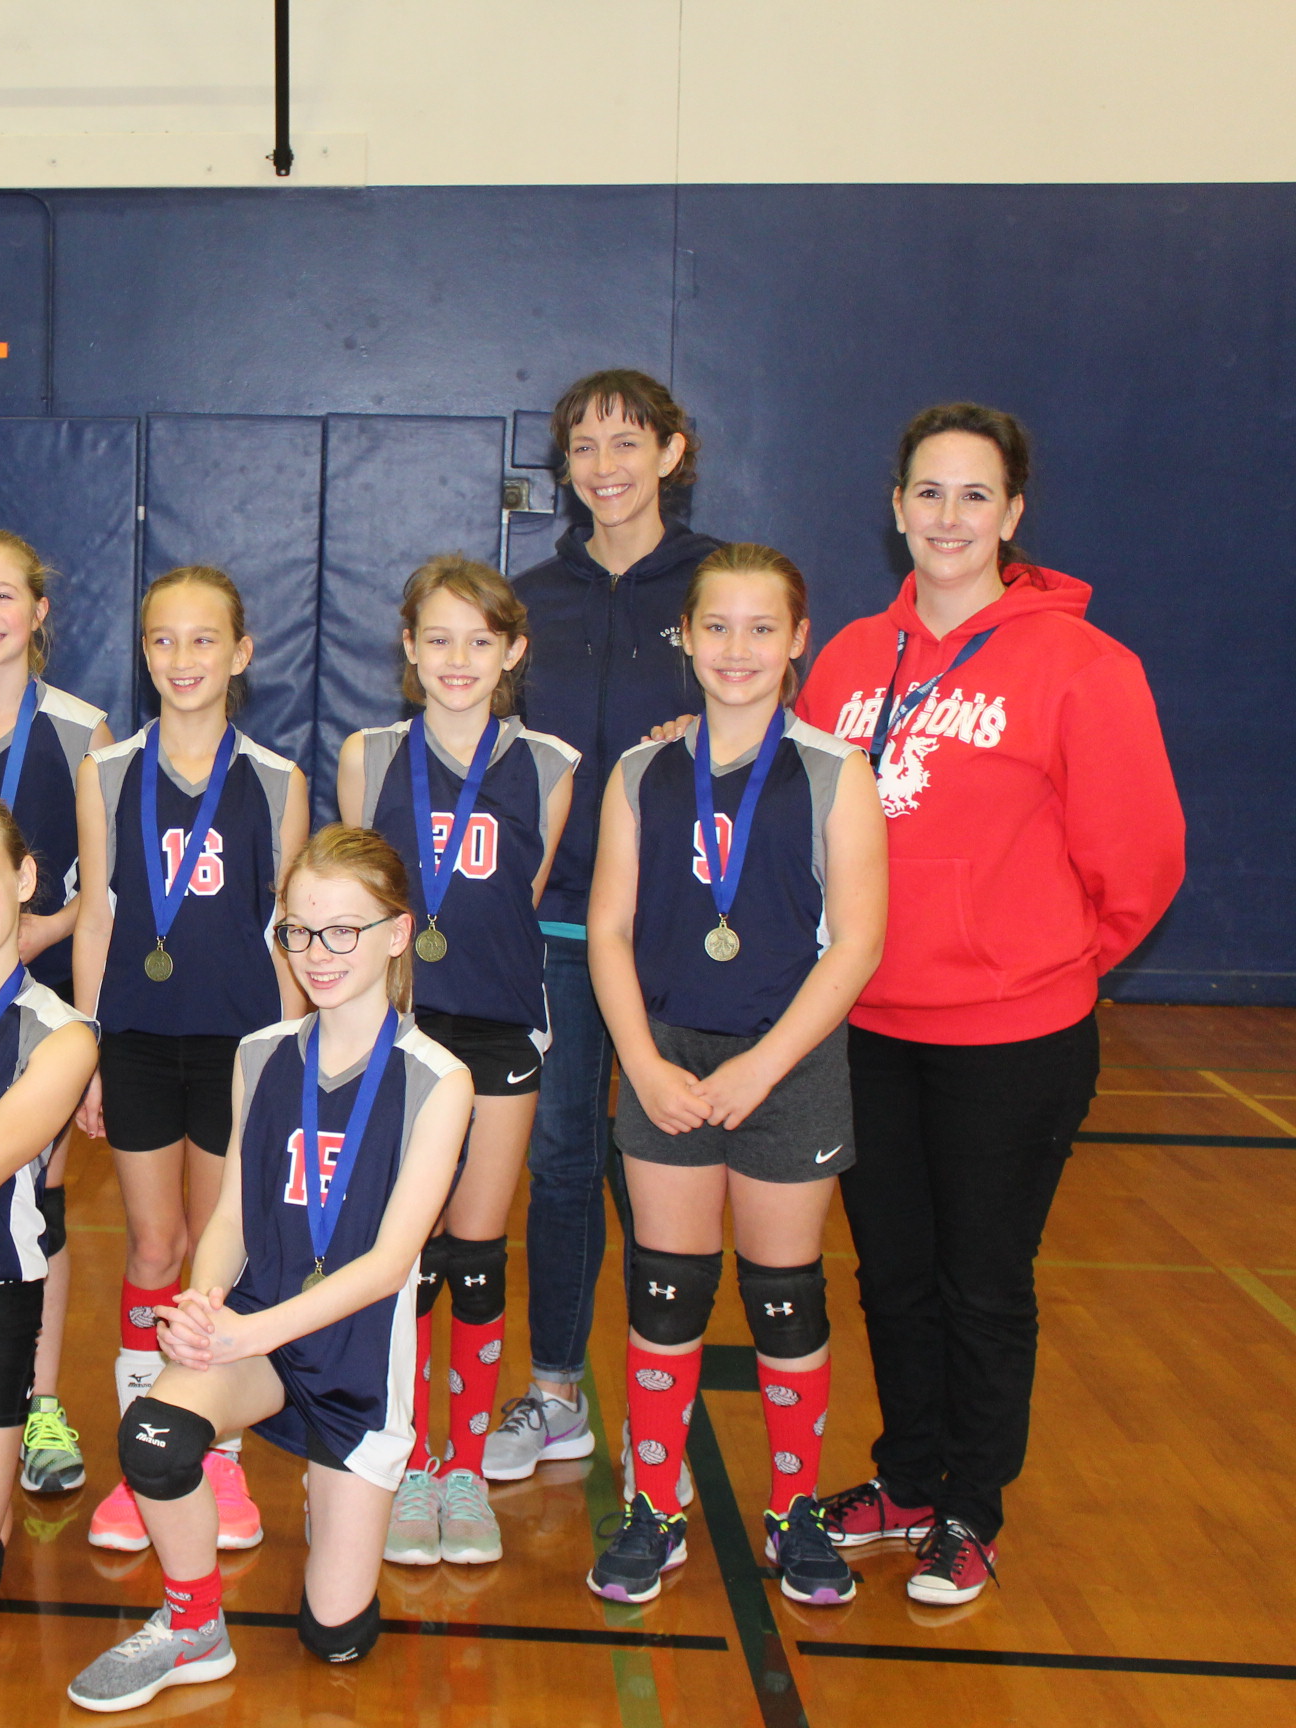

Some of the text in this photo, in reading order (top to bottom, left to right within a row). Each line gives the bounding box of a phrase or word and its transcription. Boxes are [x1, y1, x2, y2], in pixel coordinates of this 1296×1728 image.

[908, 681, 1006, 708] CLARE
[161, 827, 225, 896] 16
[692, 812, 733, 885] 9
